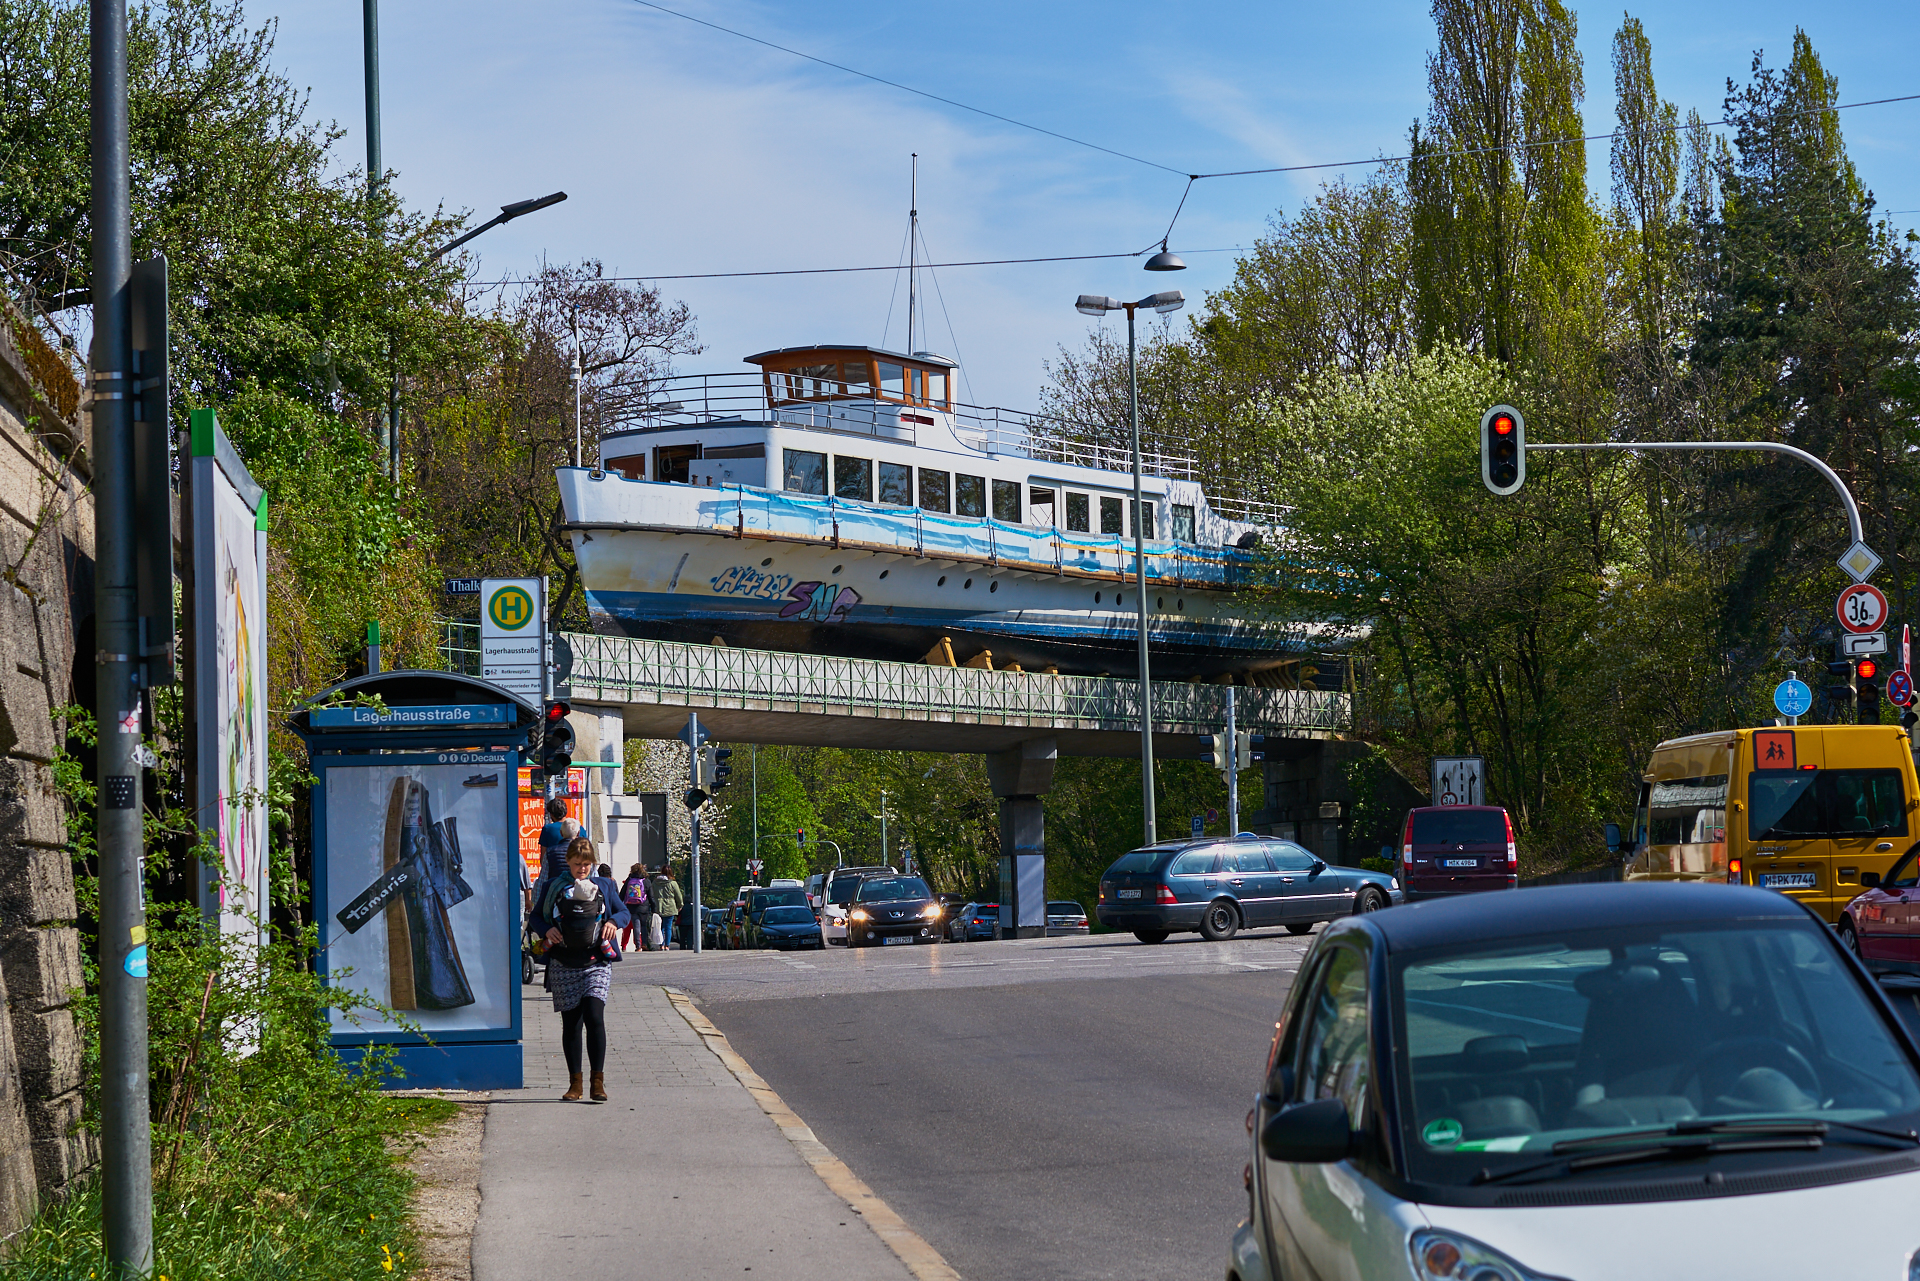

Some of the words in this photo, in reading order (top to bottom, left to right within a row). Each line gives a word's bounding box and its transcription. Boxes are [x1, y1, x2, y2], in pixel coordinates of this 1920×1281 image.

[485, 647, 539, 656] Lagerhausstraße
[353, 708, 471, 724] Lagerhausstraße
[471, 753, 505, 762] Decaux
[1765, 876, 1772, 886] M
[1778, 875, 1789, 885] PK
[1791, 875, 1814, 884] 7744
[346, 873, 408, 920] tamaris
